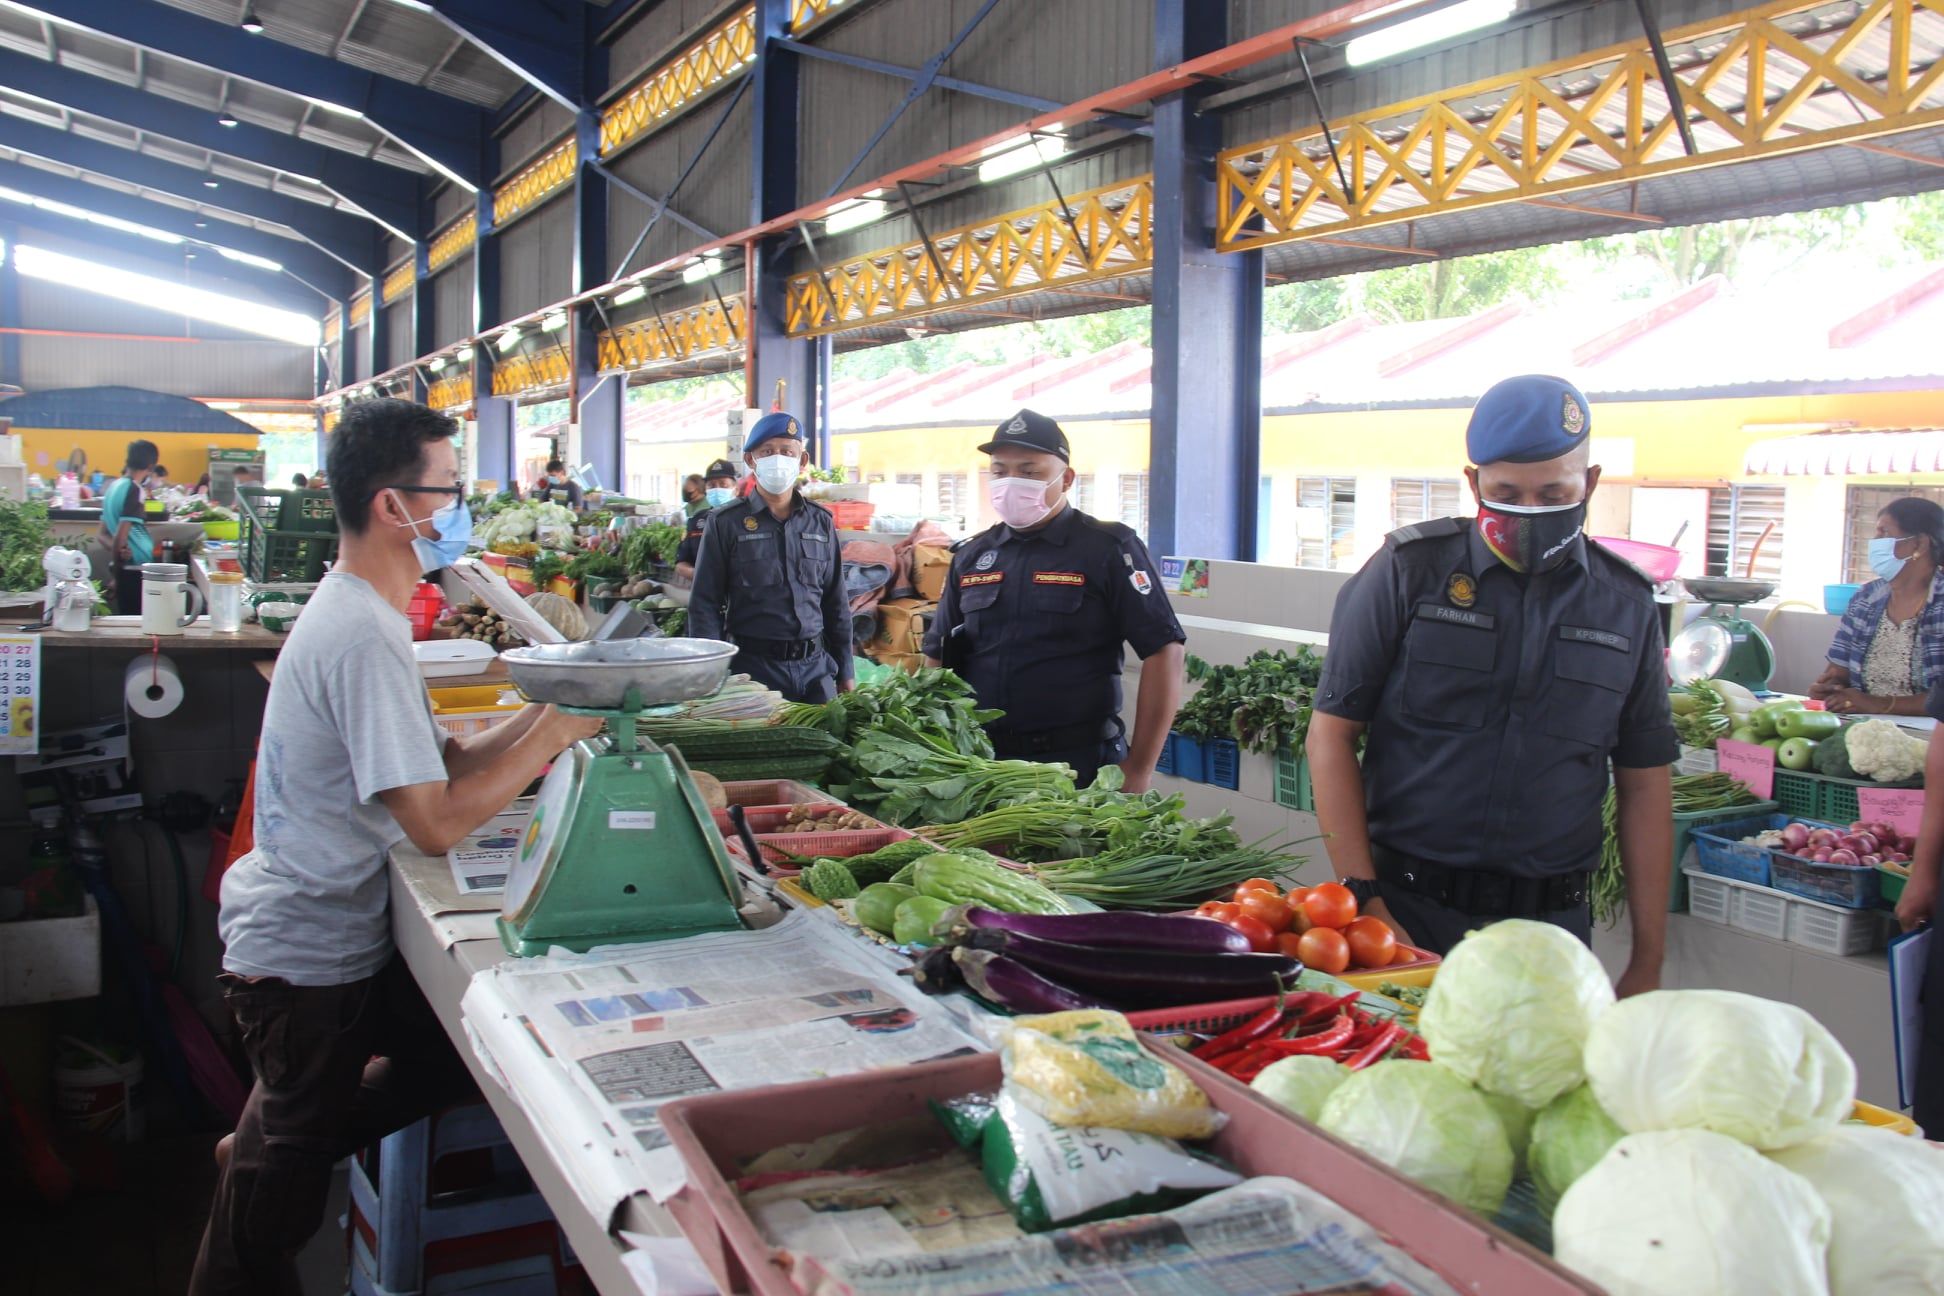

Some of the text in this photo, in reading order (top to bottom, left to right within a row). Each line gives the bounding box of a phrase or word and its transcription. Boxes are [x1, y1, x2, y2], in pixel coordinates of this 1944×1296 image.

[1436, 607, 1477, 624] FARHAN
[15, 645, 32, 655] 27
[0, 659, 31, 668] 1 28
[0, 672, 31, 681] 2 29
[0, 685, 31, 695] 3 30
